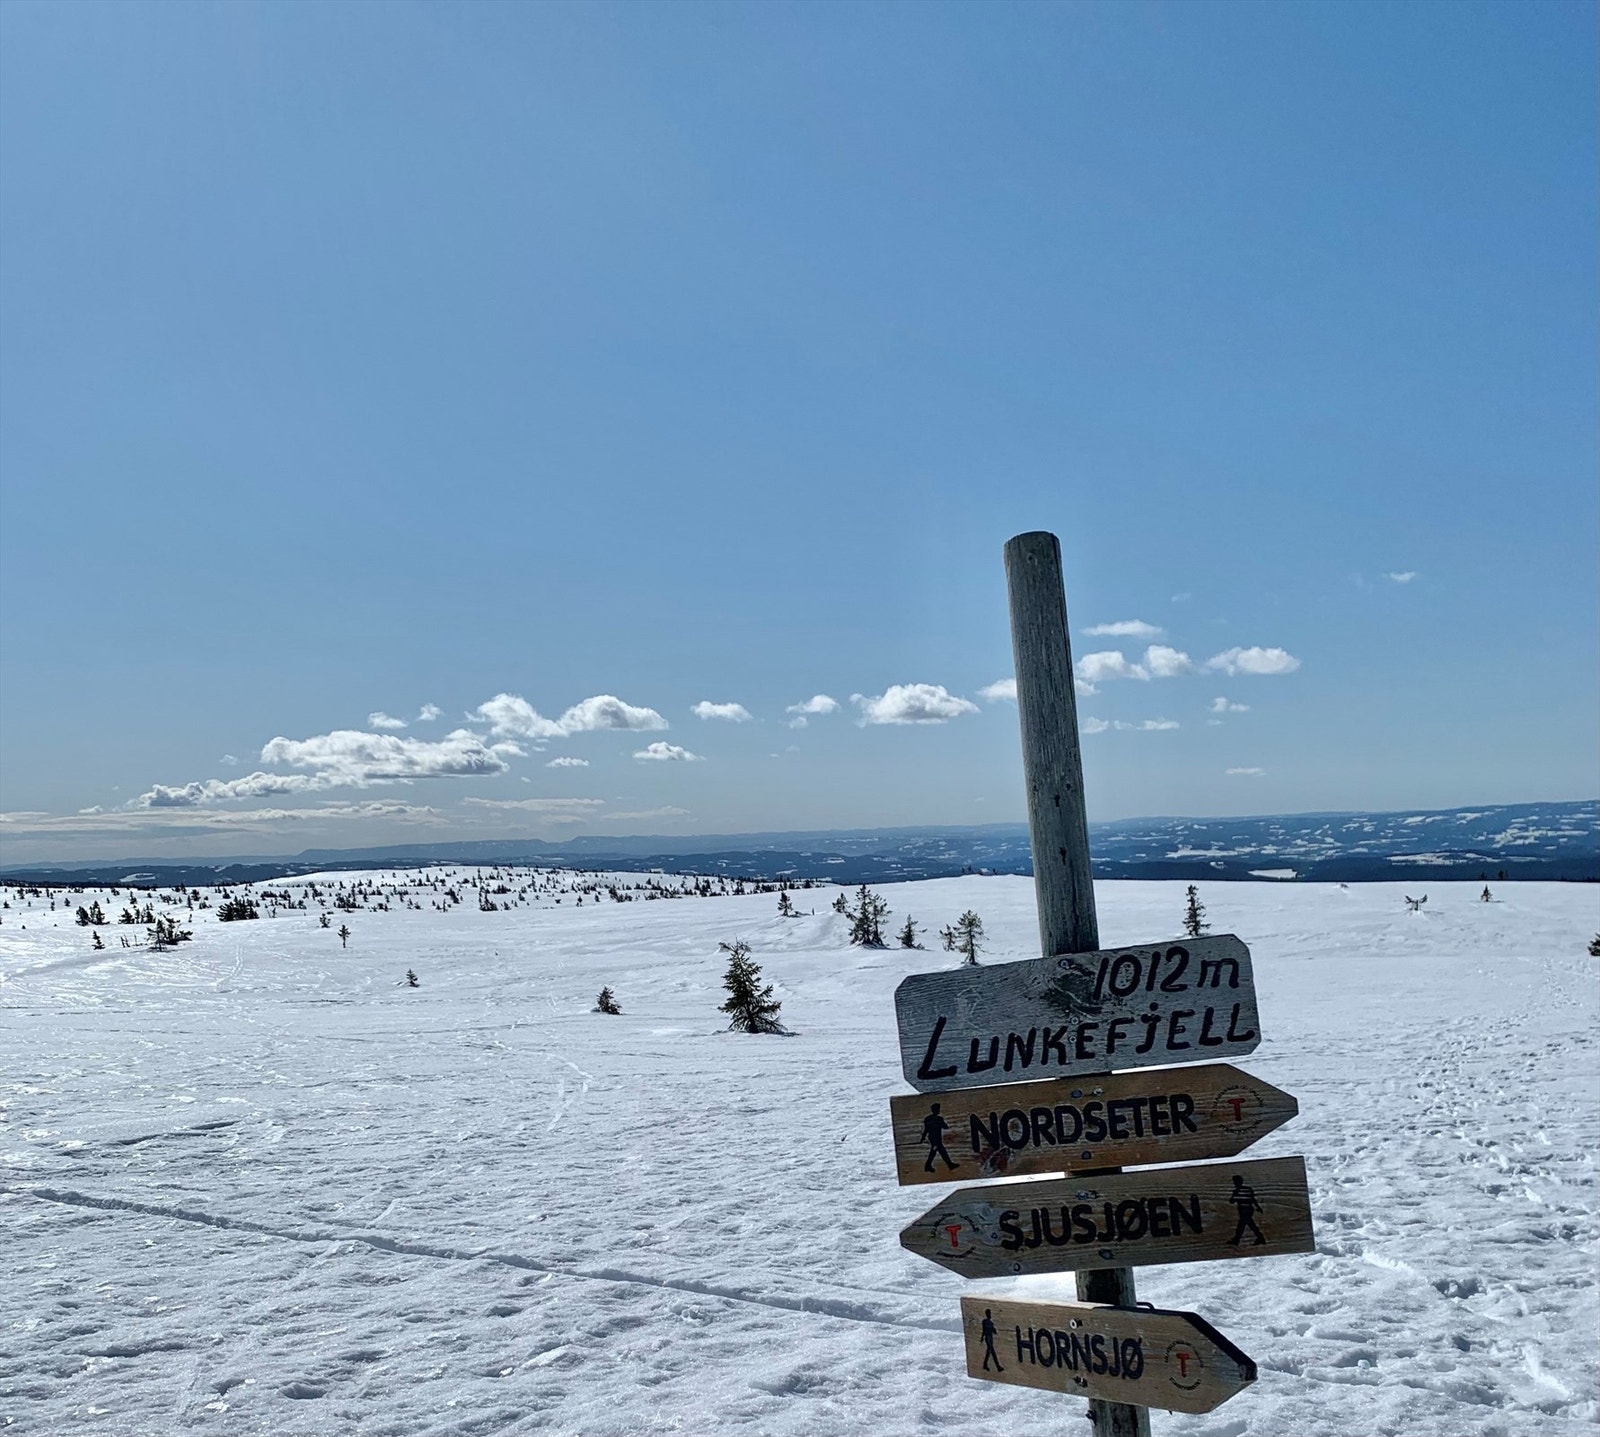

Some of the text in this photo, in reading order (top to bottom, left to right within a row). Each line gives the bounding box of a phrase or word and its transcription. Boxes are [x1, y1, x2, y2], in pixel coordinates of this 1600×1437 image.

[1093, 946, 1240, 1000] 1012 m
[969, 1093, 1198, 1153] NORDSETER
[1227, 1098, 1247, 1121] T
[944, 1224, 962, 1247] T
[999, 1193, 1203, 1251] SJUSJØEN
[1015, 1325, 1145, 1380] HORNSJØ
[1176, 1353, 1191, 1377] T
